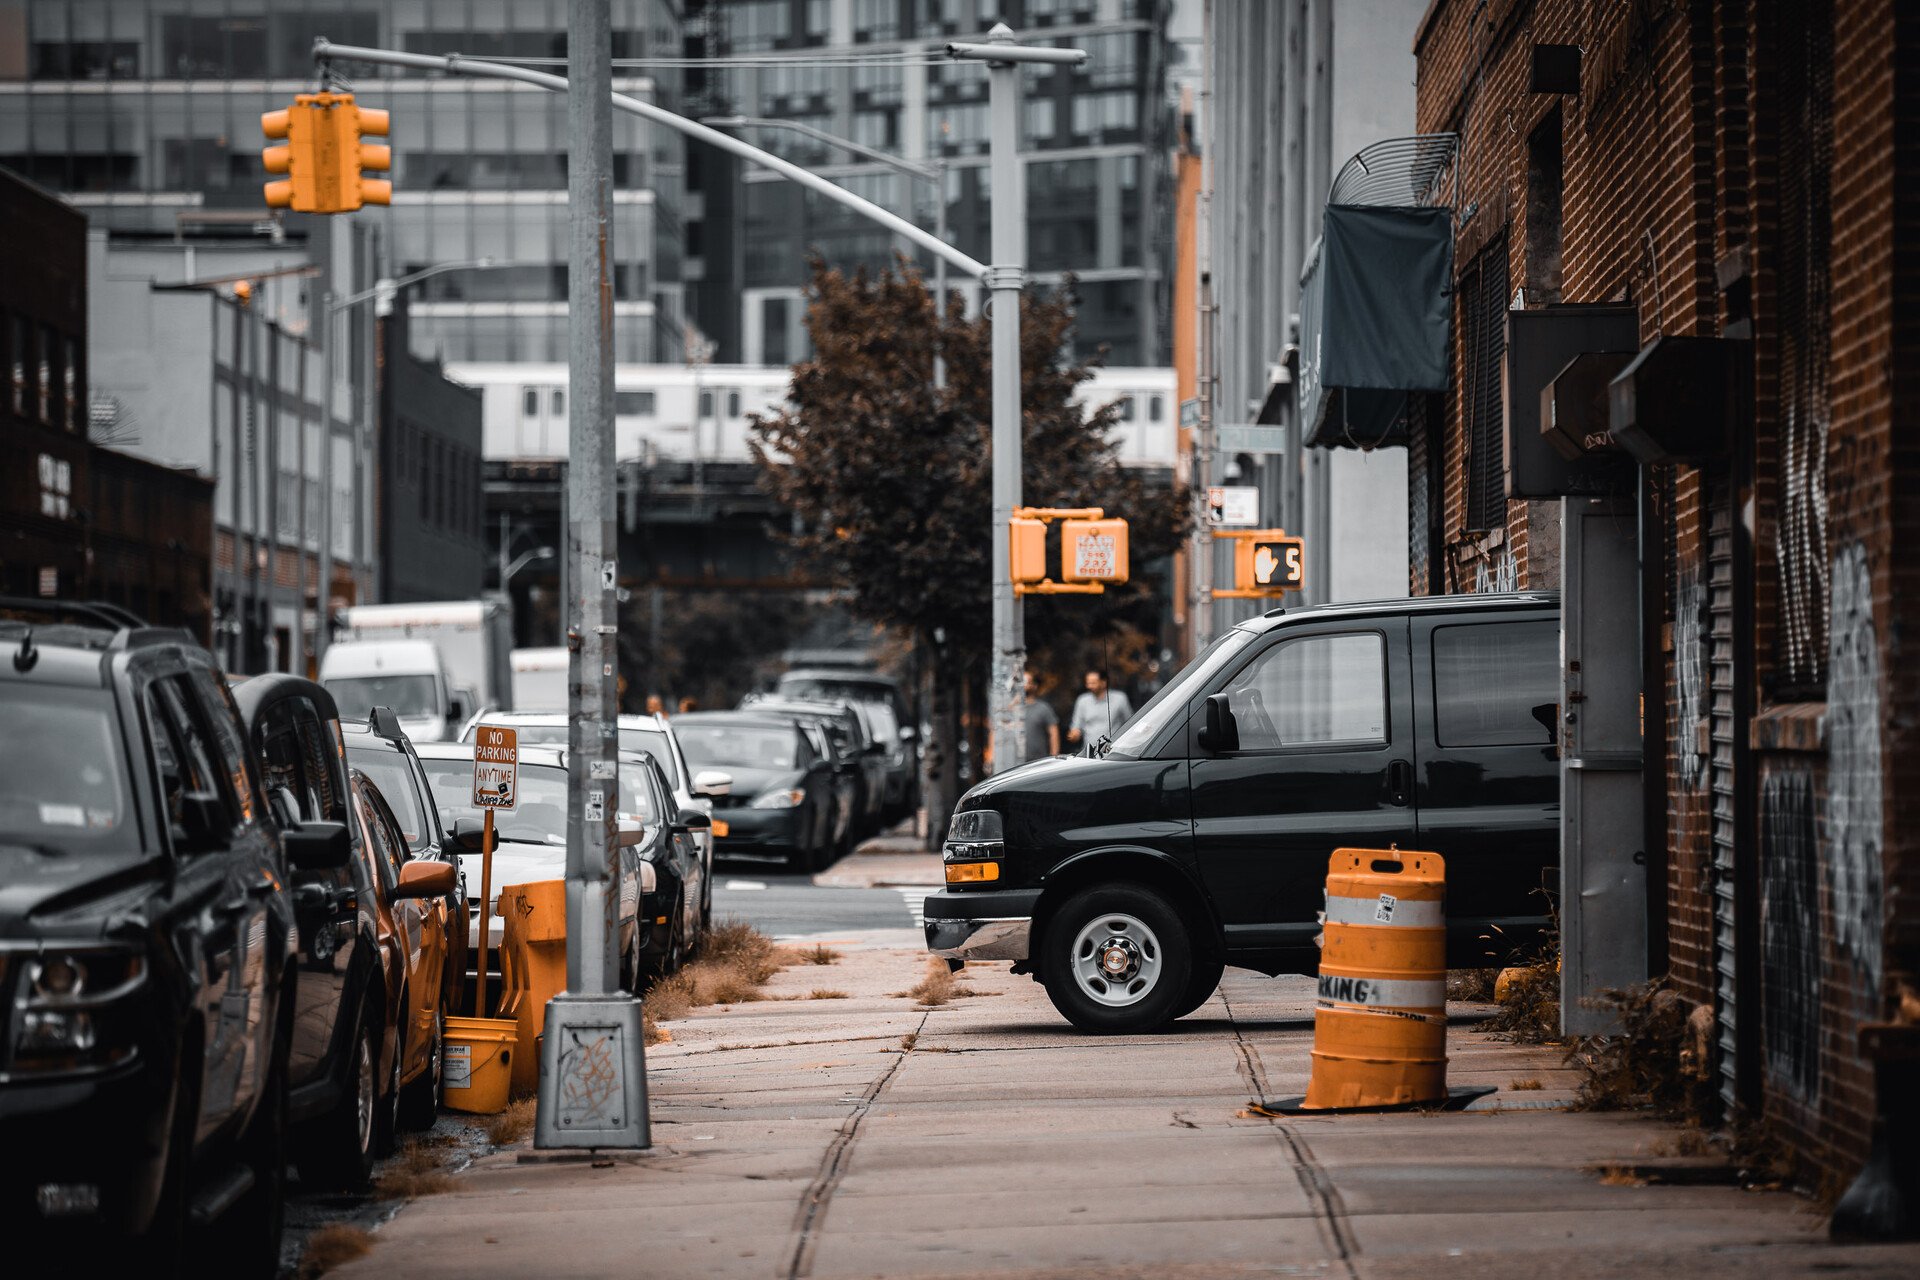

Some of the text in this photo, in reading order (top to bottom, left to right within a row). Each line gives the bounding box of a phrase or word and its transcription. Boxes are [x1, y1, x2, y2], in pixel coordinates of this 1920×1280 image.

[1285, 547, 1301, 581] 5
[488, 731, 503, 745] NO
[476, 745, 515, 762] PARKING
[477, 768, 512, 783] ANYTIME
